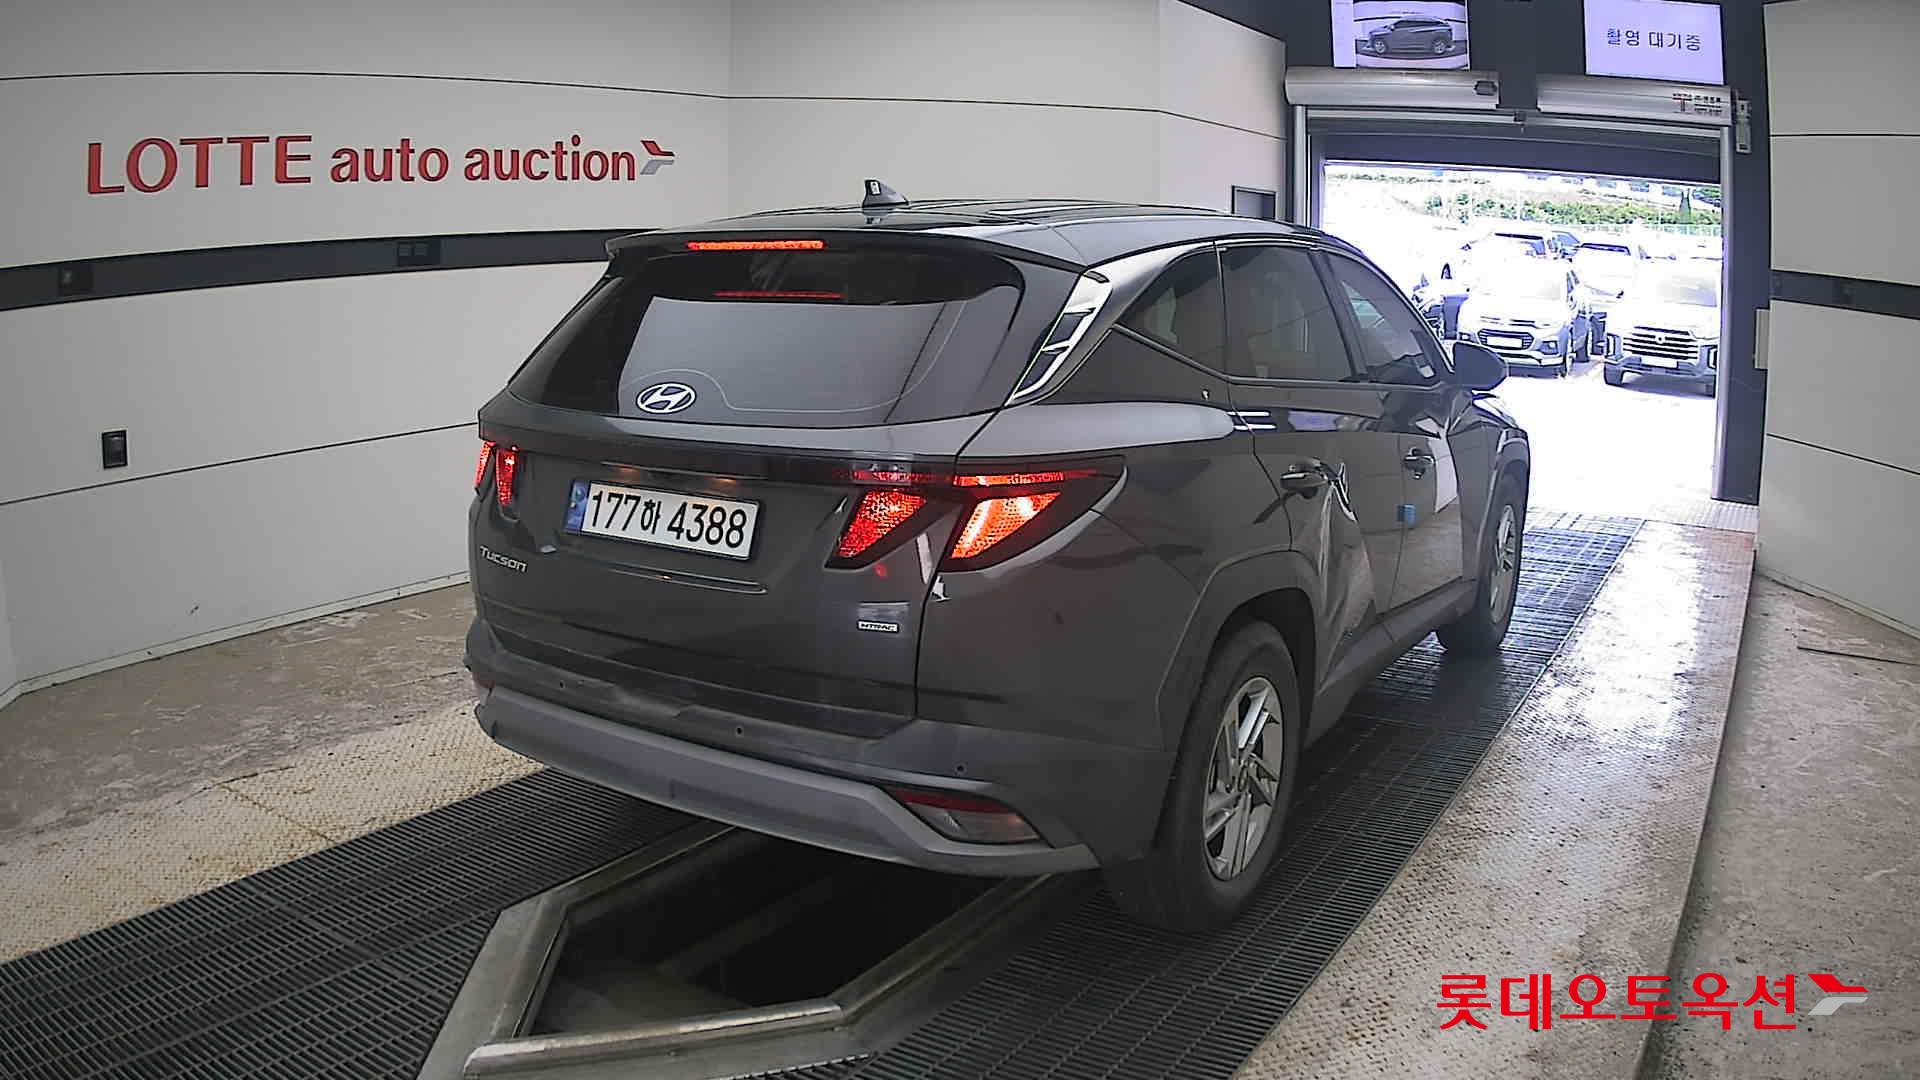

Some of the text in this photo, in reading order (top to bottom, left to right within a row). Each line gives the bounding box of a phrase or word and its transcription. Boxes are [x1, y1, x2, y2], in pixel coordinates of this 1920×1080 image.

[1648, 31, 1701, 51] 대기중
[86, 135, 637, 195] LOTTE auto auction
[592, 490, 748, 549] 177하 4388
